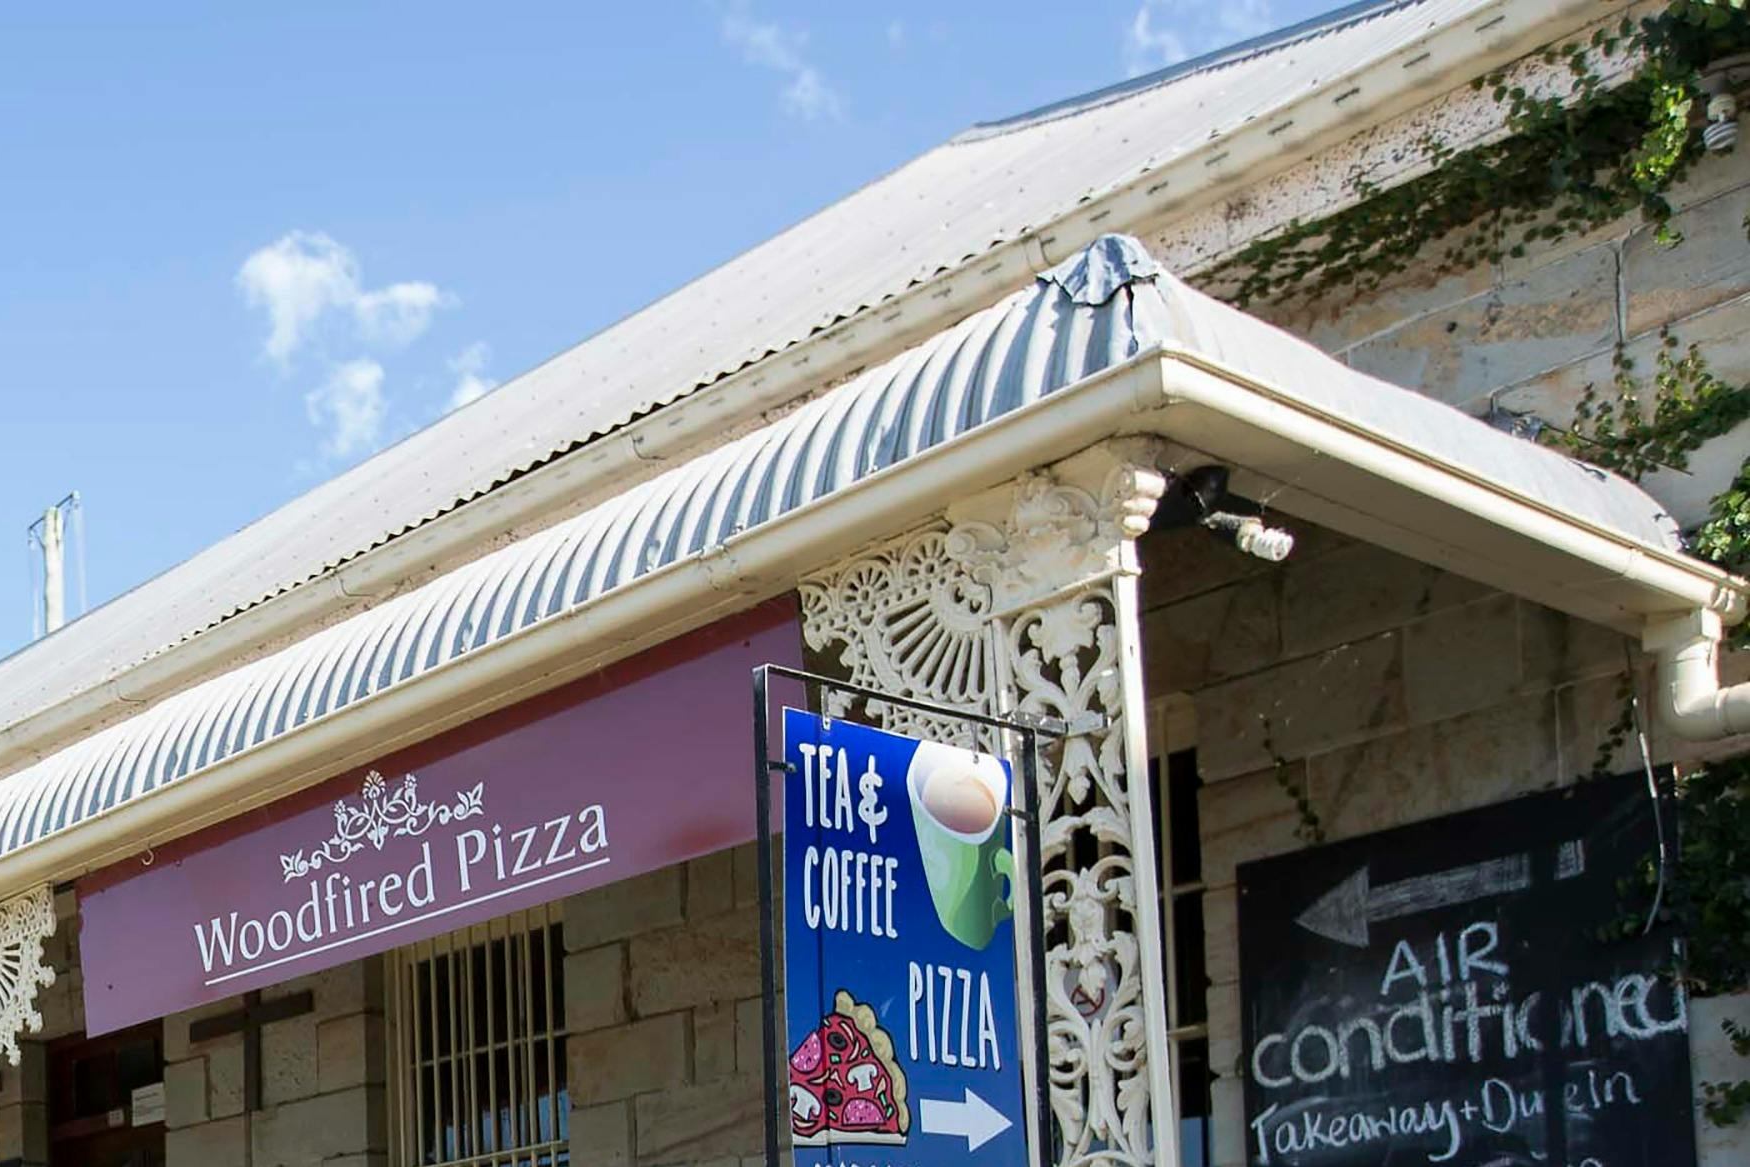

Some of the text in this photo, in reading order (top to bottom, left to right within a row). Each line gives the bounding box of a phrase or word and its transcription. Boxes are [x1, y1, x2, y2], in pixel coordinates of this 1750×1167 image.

[193, 803, 609, 972] Woodfired Pizza
[803, 846, 899, 940] COFFEE
[1380, 920, 1510, 995] AIR
[908, 960, 1001, 1071] PIZZA
